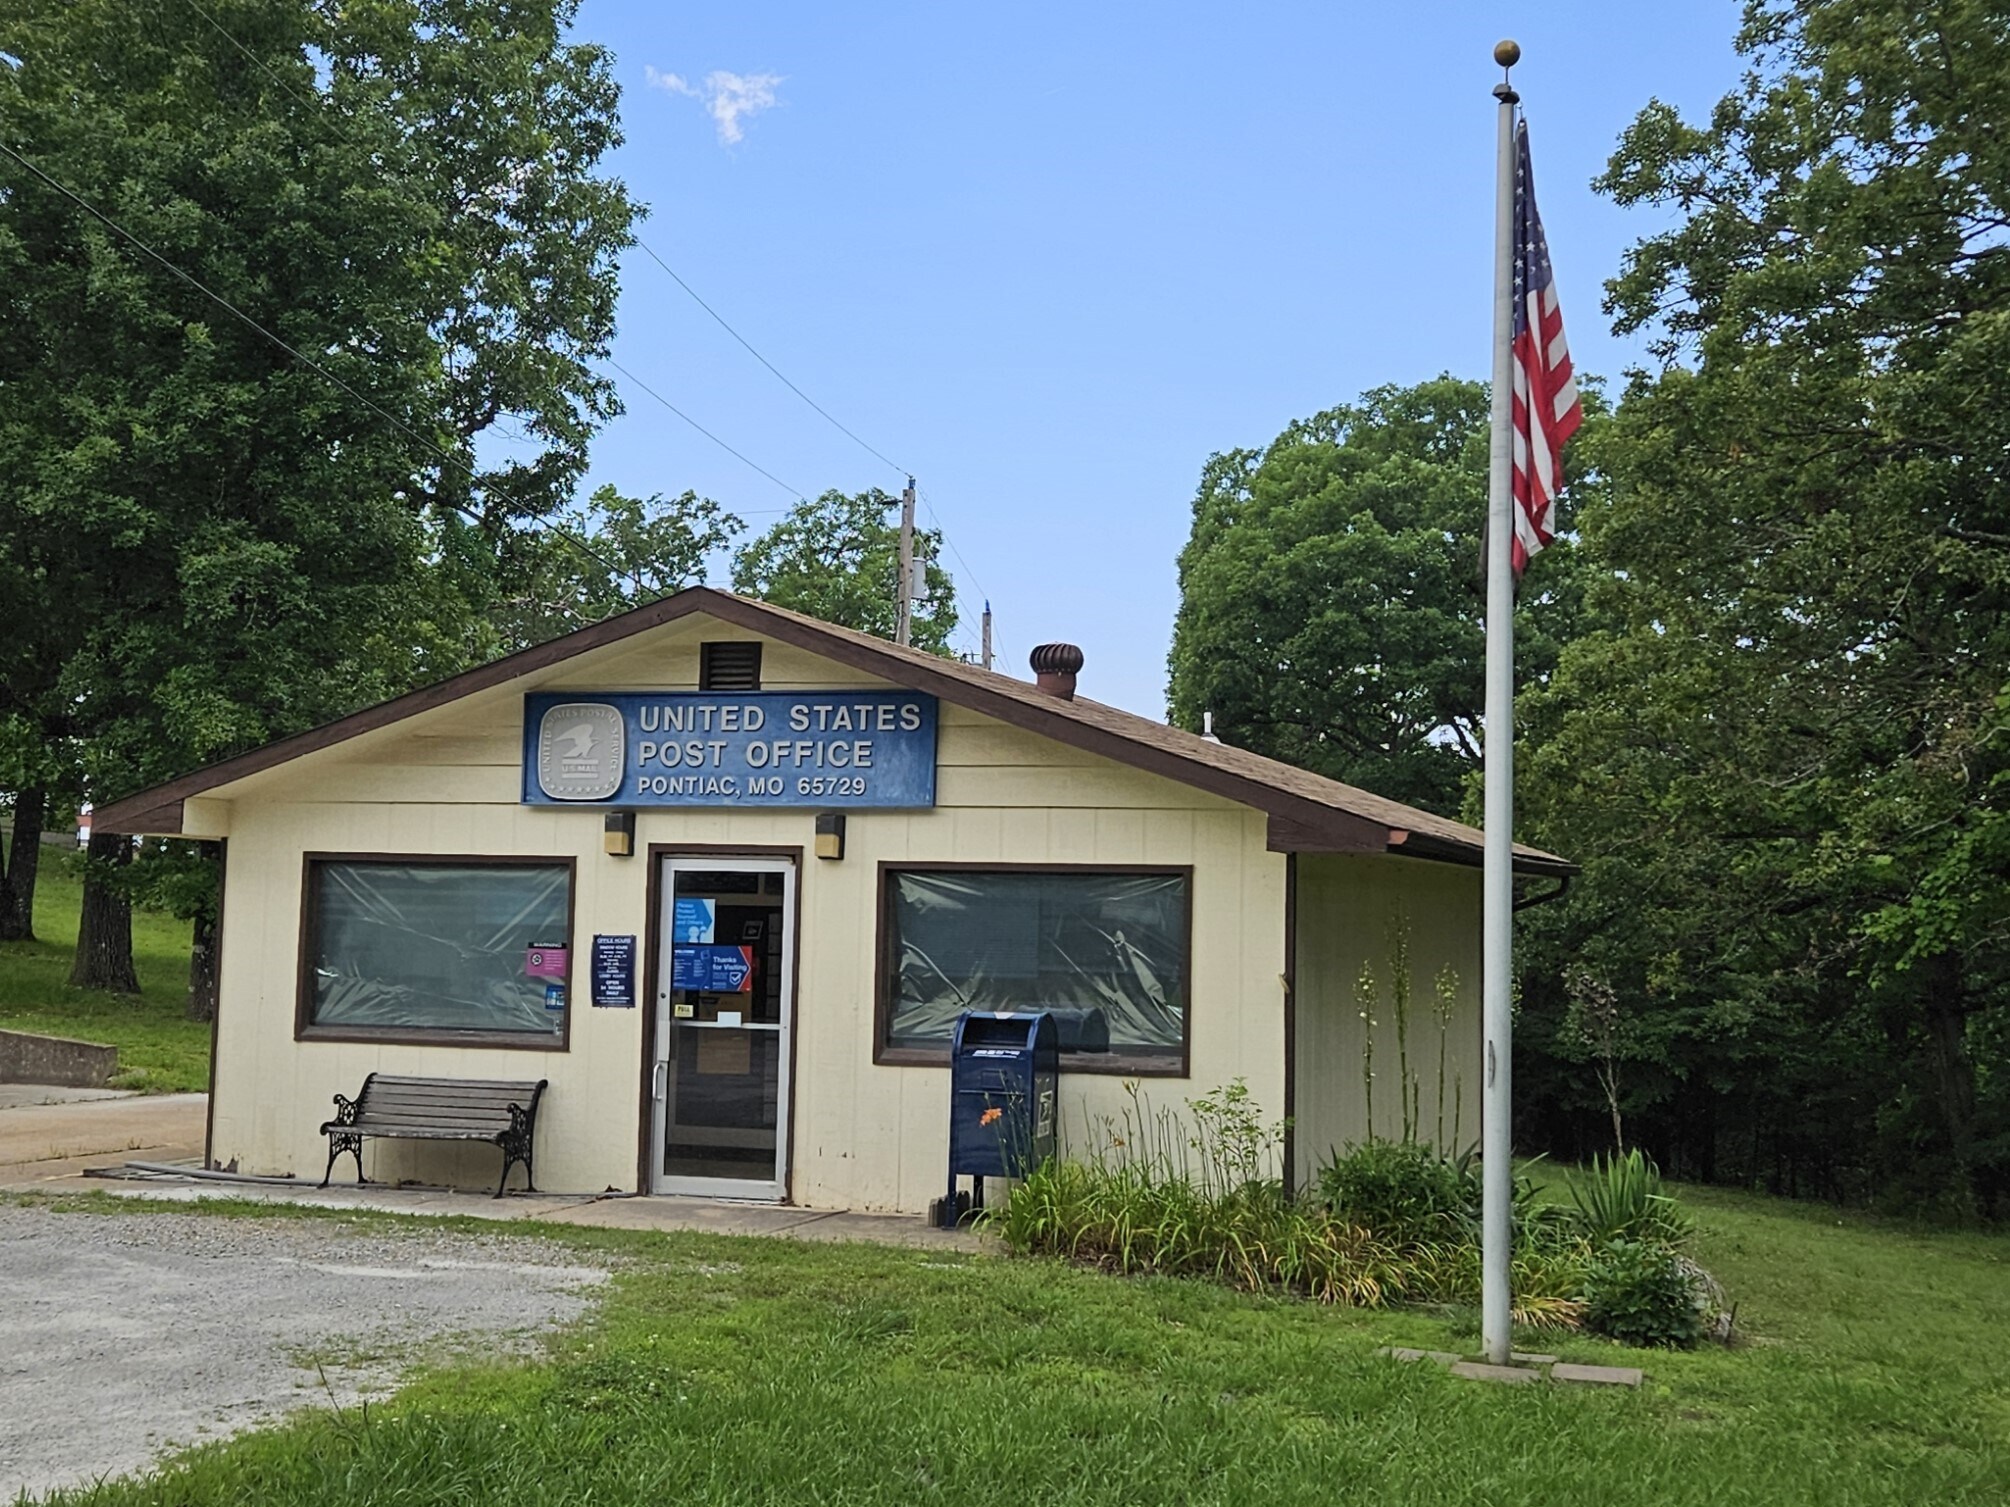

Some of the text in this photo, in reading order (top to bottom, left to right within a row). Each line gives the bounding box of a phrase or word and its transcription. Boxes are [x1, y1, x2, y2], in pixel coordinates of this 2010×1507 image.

[639, 703, 921, 732] UNITED STATES
[543, 708, 619, 773] UNITED STATES POSTAL SERVICE
[637, 740, 874, 768] POST OFFICE
[637, 776, 867, 799] PONTIAC, MO 65729
[723, 964, 748, 972] Visiting
